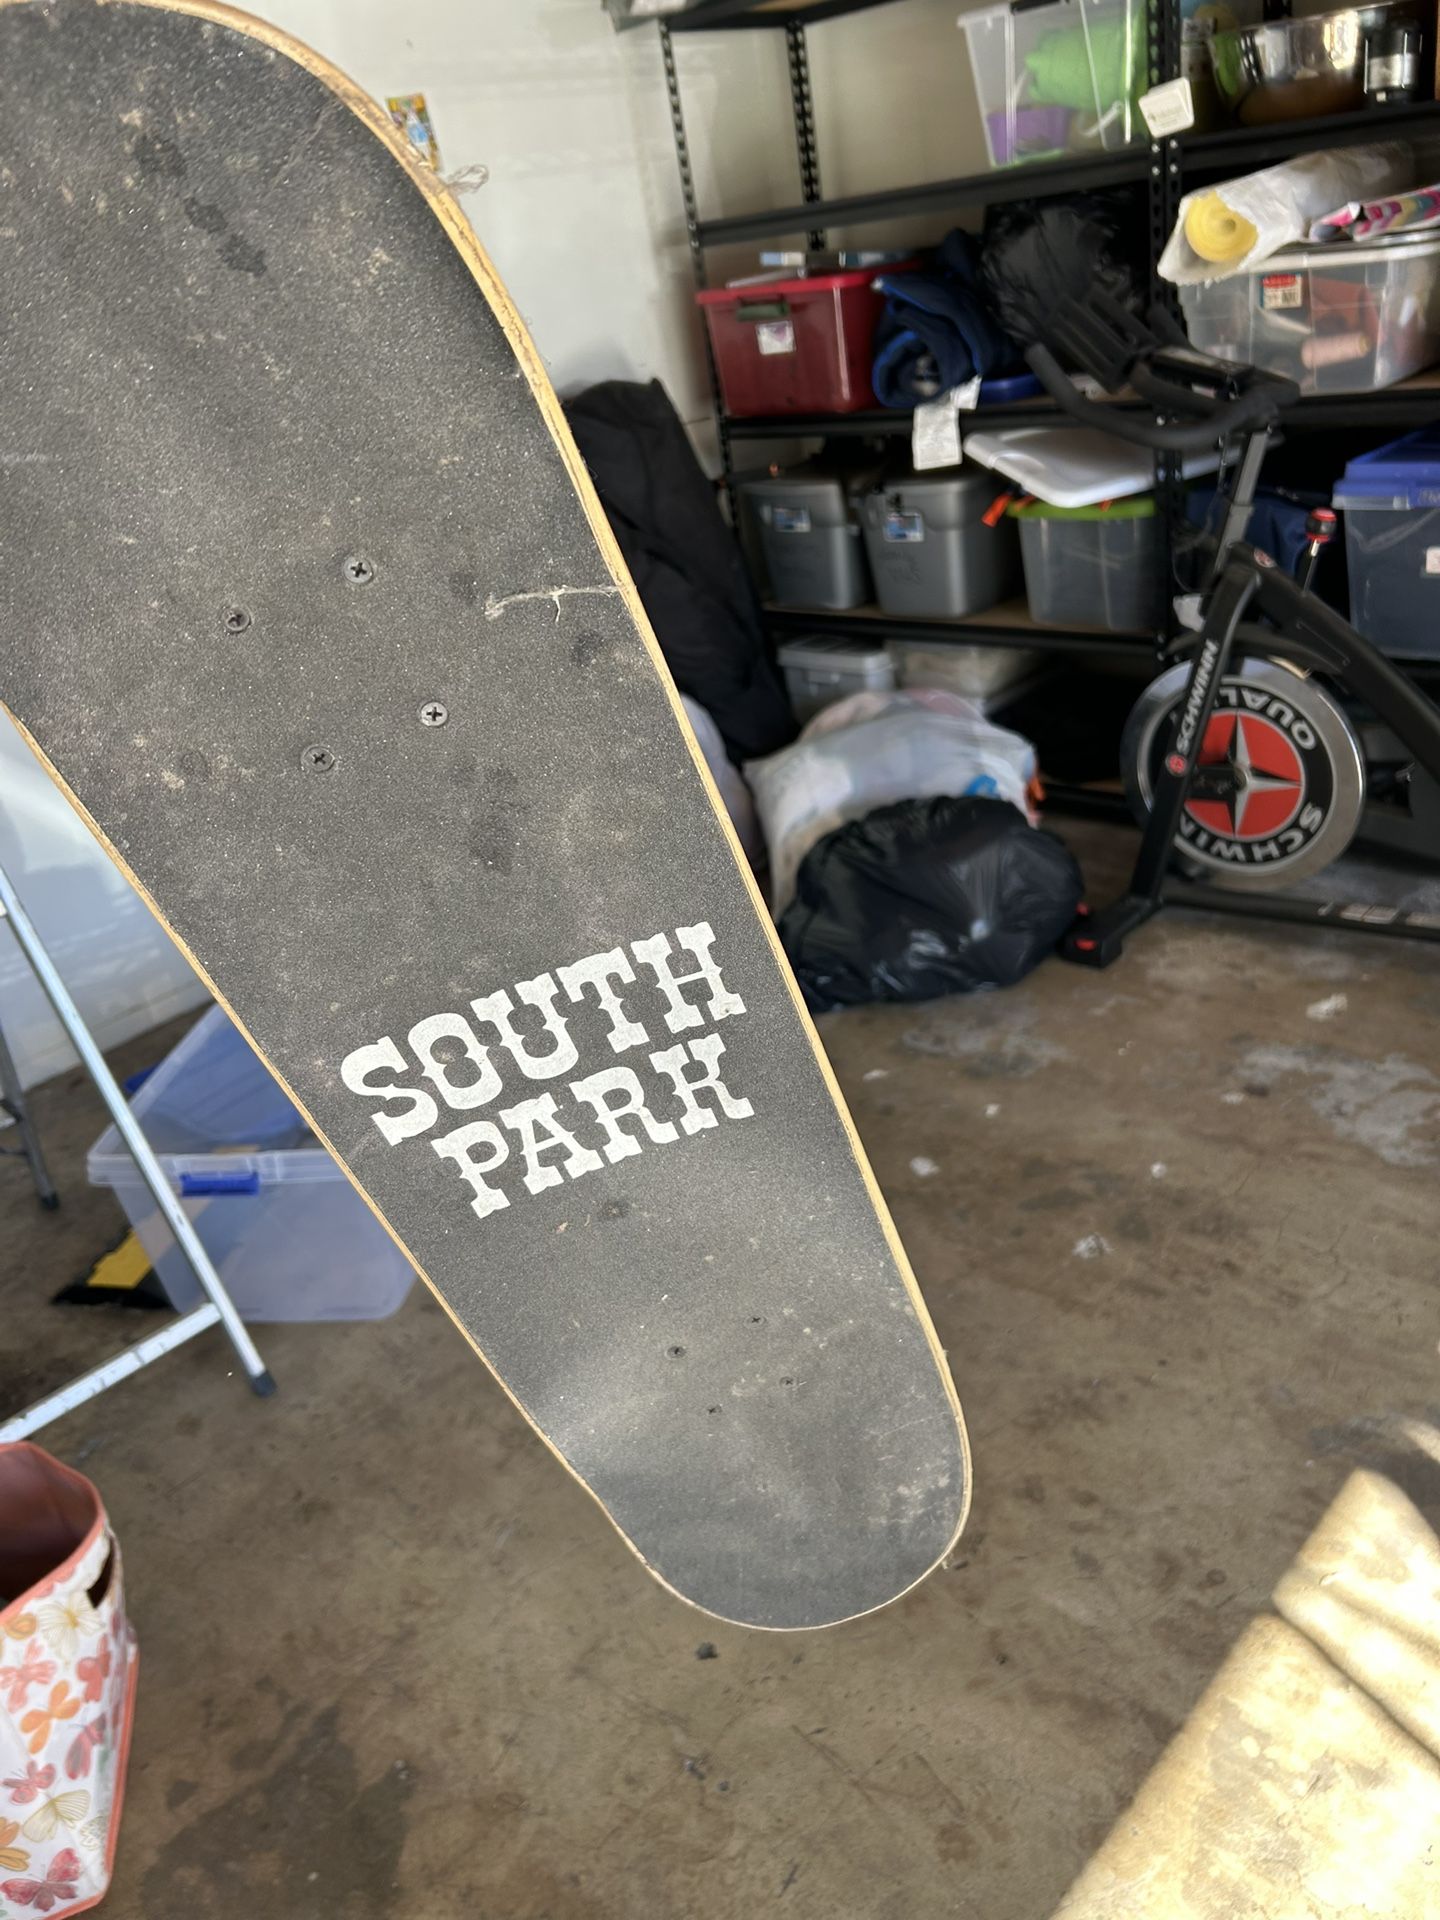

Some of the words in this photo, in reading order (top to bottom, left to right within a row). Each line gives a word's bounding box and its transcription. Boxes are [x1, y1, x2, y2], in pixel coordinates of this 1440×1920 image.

[1176, 638, 1219, 756] SCHWINN
[1213, 686, 1317, 751] QUAL
[1179, 803, 1323, 862] SCHWIN
[340, 921, 747, 1147] SOUTH
[430, 1032, 755, 1219] PARK
